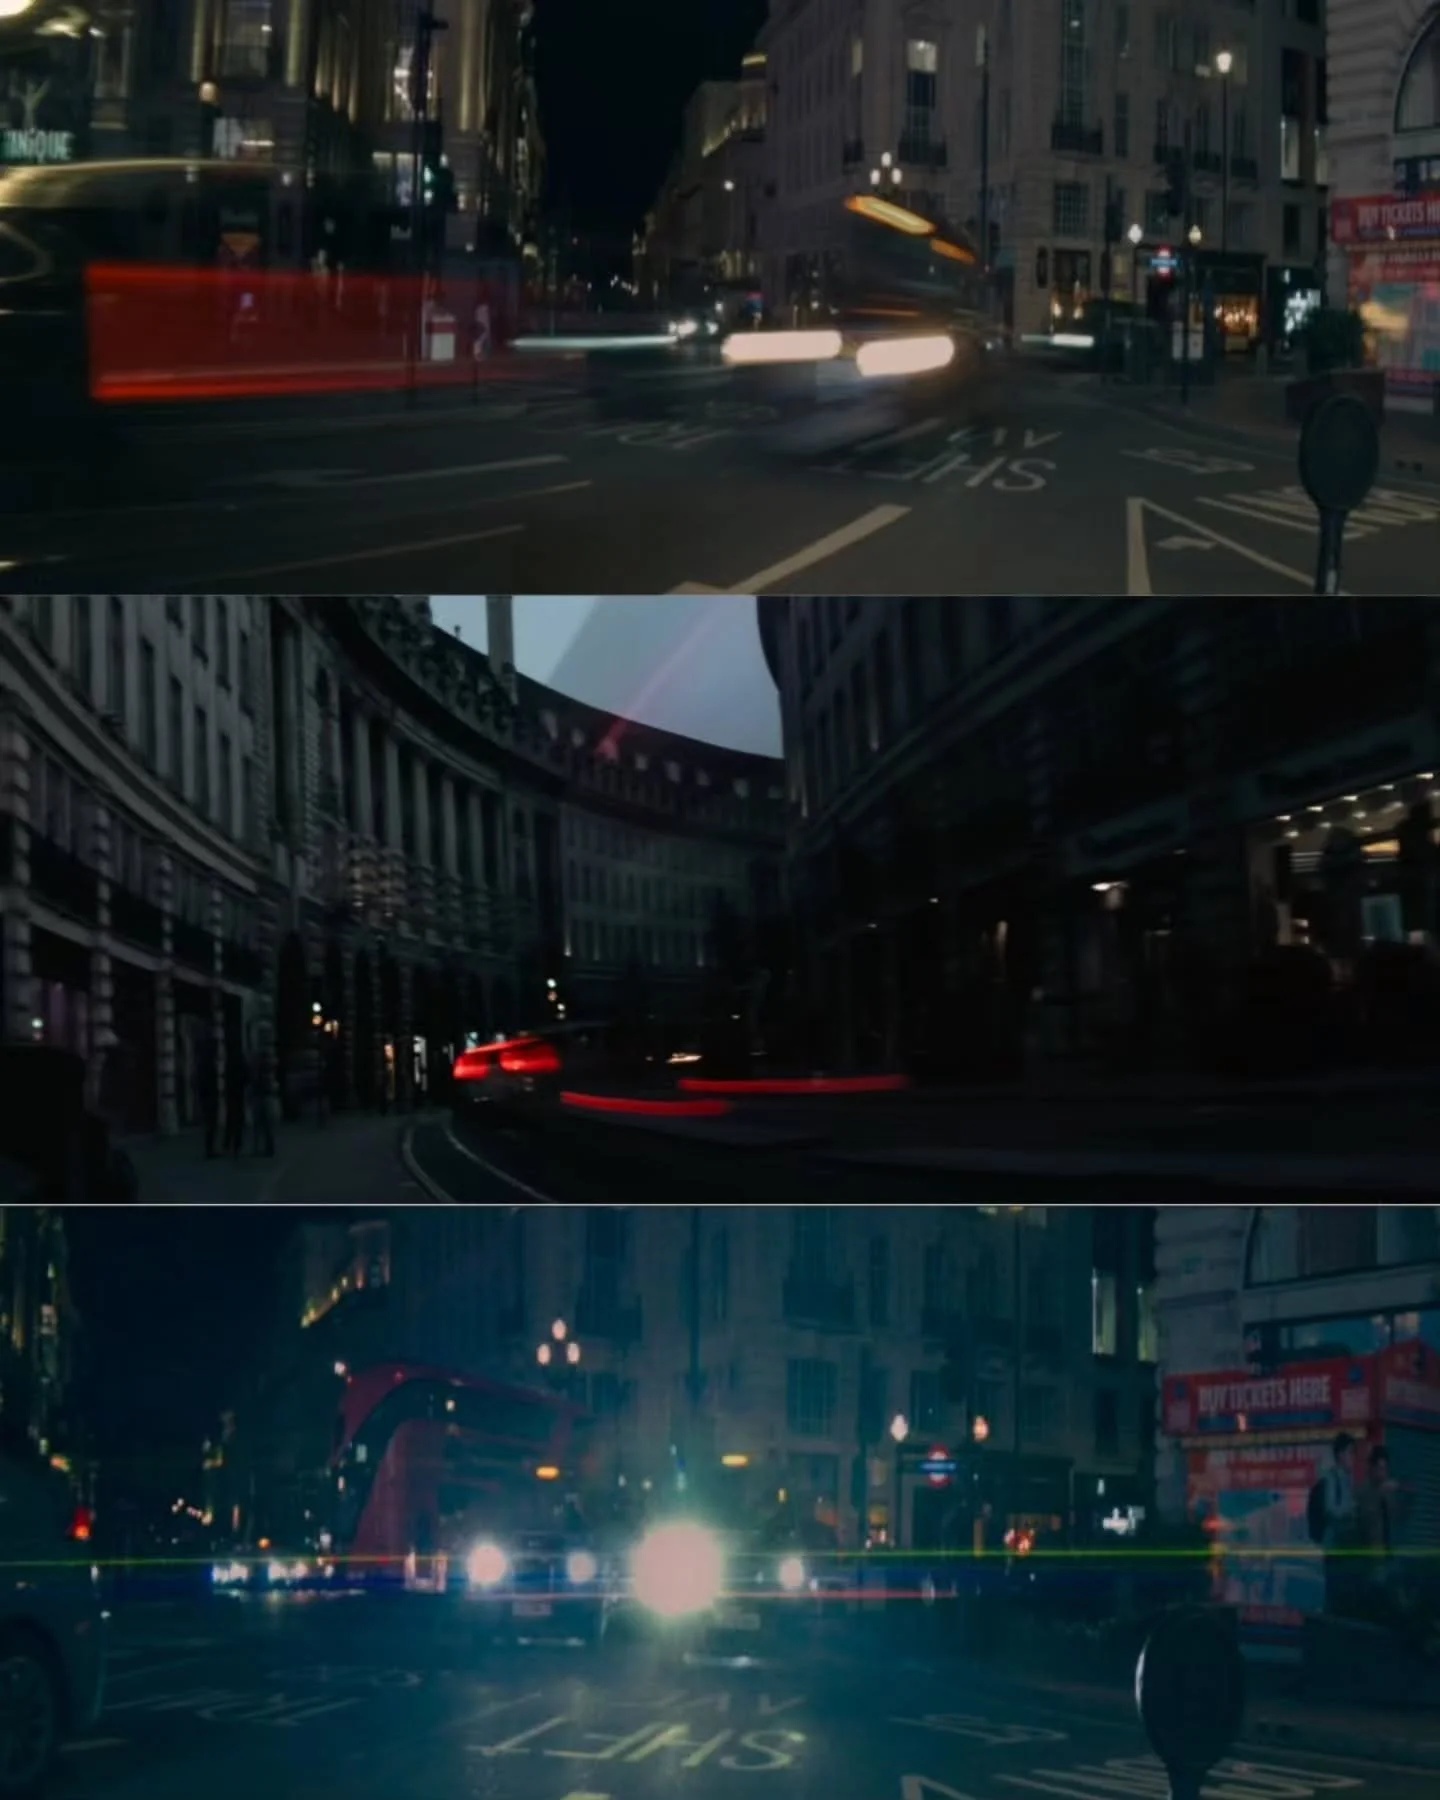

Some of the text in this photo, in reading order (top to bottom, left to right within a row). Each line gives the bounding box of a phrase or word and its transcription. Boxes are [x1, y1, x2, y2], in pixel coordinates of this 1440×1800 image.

[1381, 201, 1424, 225] TICKETS
[1199, 1384, 1227, 1412] BUY
[1229, 1377, 1288, 1411] TICKETS
[1290, 1374, 1332, 1406] HERE
